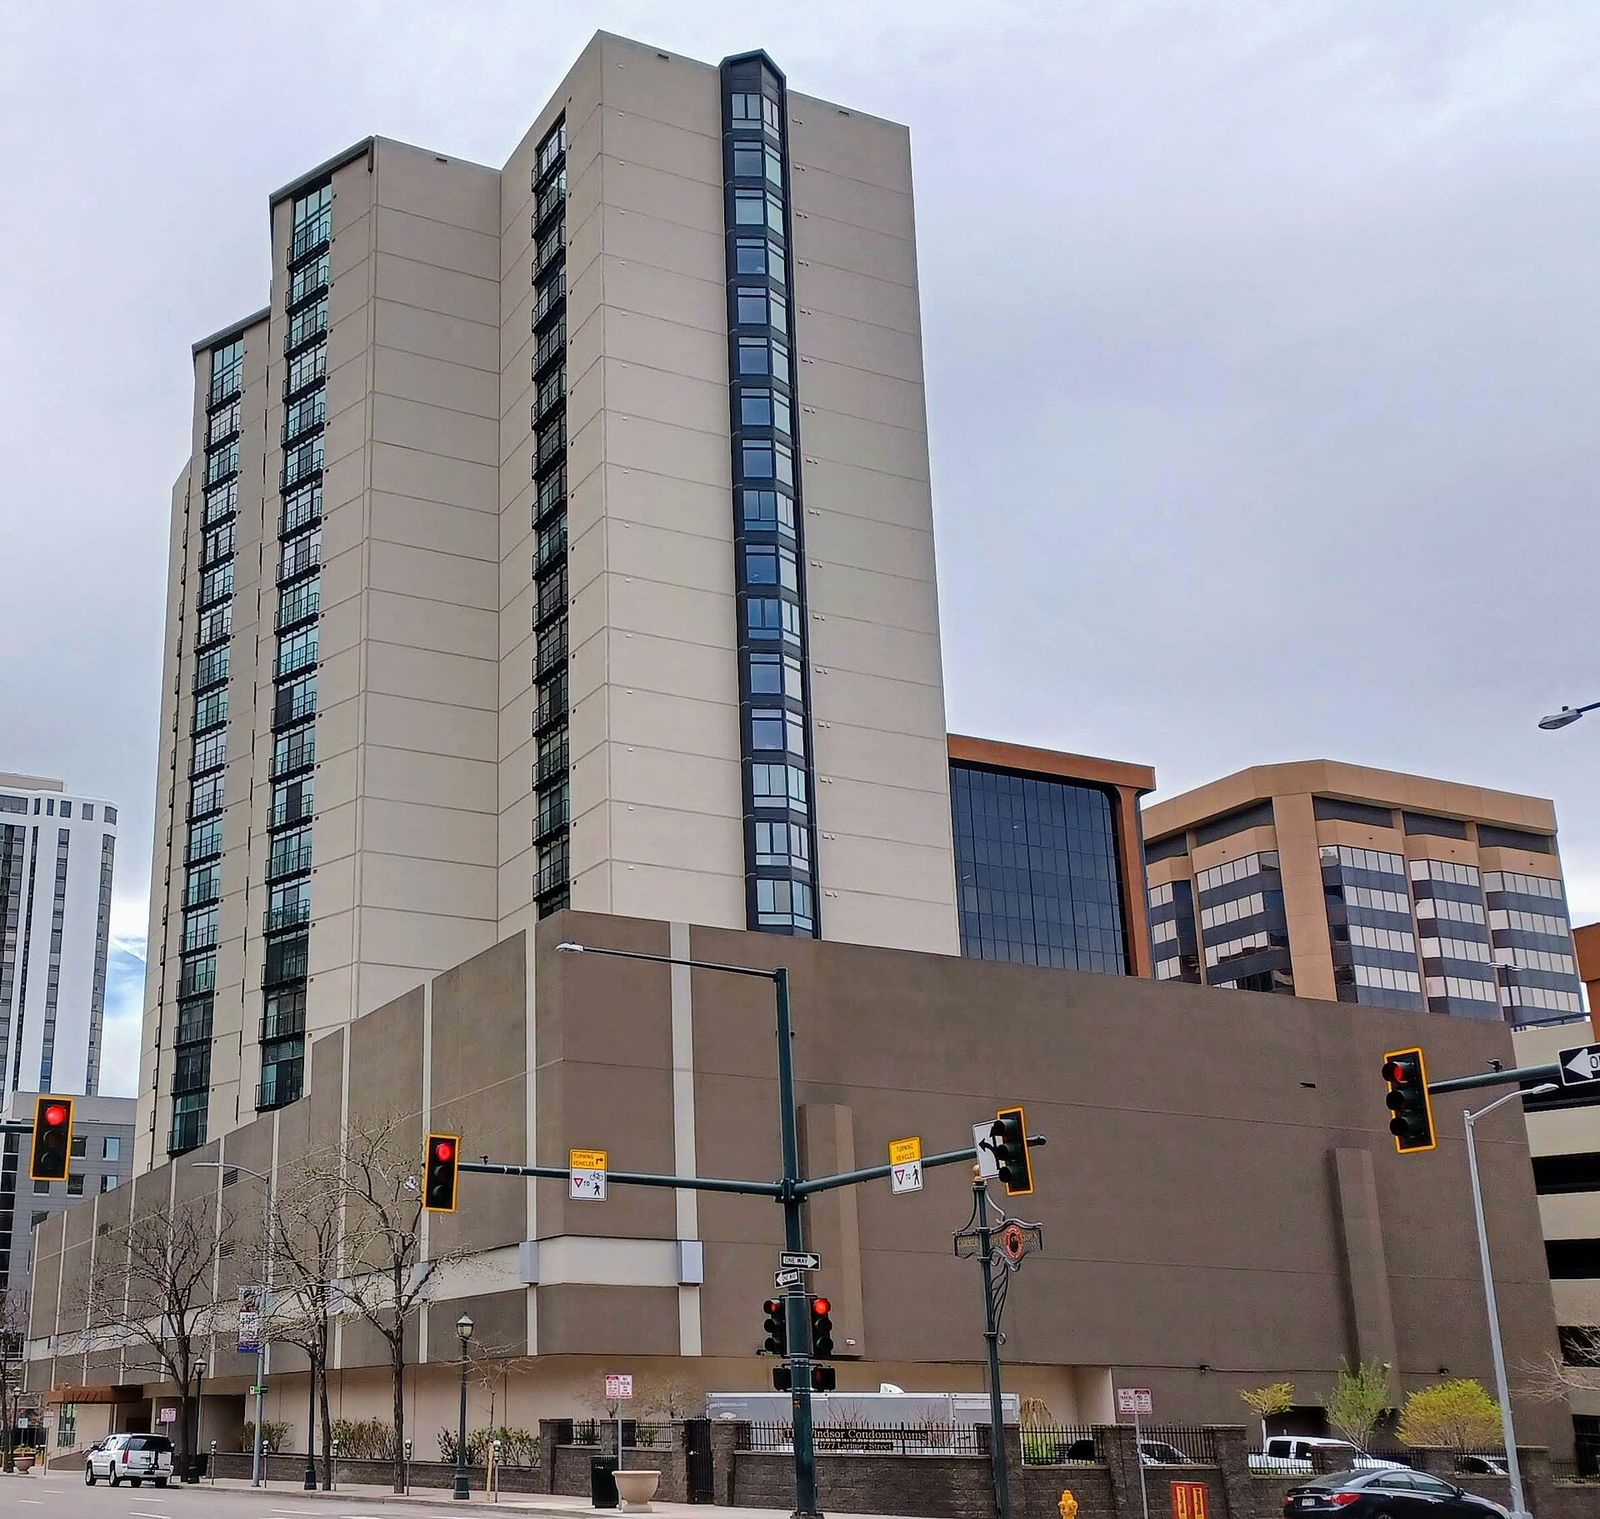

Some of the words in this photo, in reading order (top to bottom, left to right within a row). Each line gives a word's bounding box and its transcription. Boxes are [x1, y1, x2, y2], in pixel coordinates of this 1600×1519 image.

[811, 1429, 845, 1438] indsor
[848, 1429, 927, 1440] Condominiums
[837, 1442, 867, 1450] Larimer
